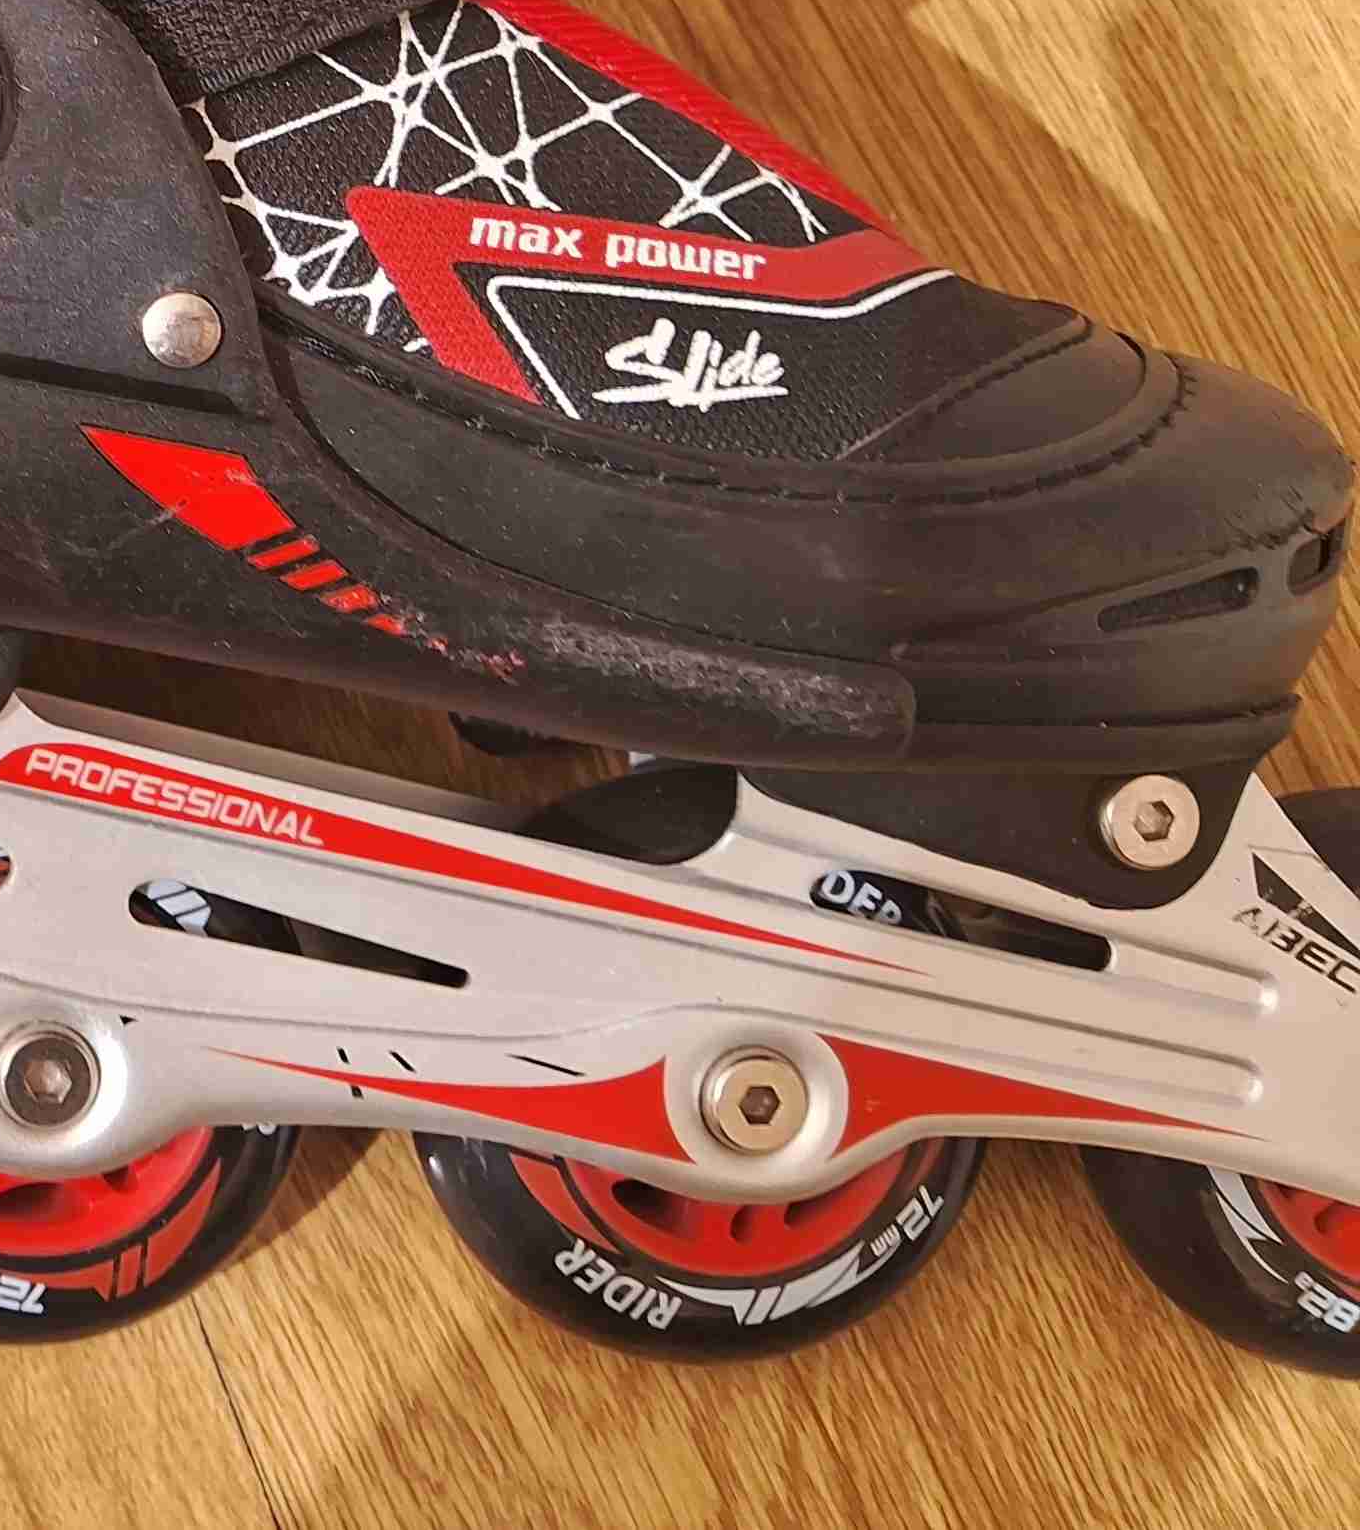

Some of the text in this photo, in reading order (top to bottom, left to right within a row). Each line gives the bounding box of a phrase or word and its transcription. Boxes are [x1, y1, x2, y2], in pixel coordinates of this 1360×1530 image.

[468, 217, 767, 280] max power
[591, 318, 789, 412] Slide
[26, 748, 324, 847] PROFESSIONAL
[554, 1237, 682, 1330] RIDER
